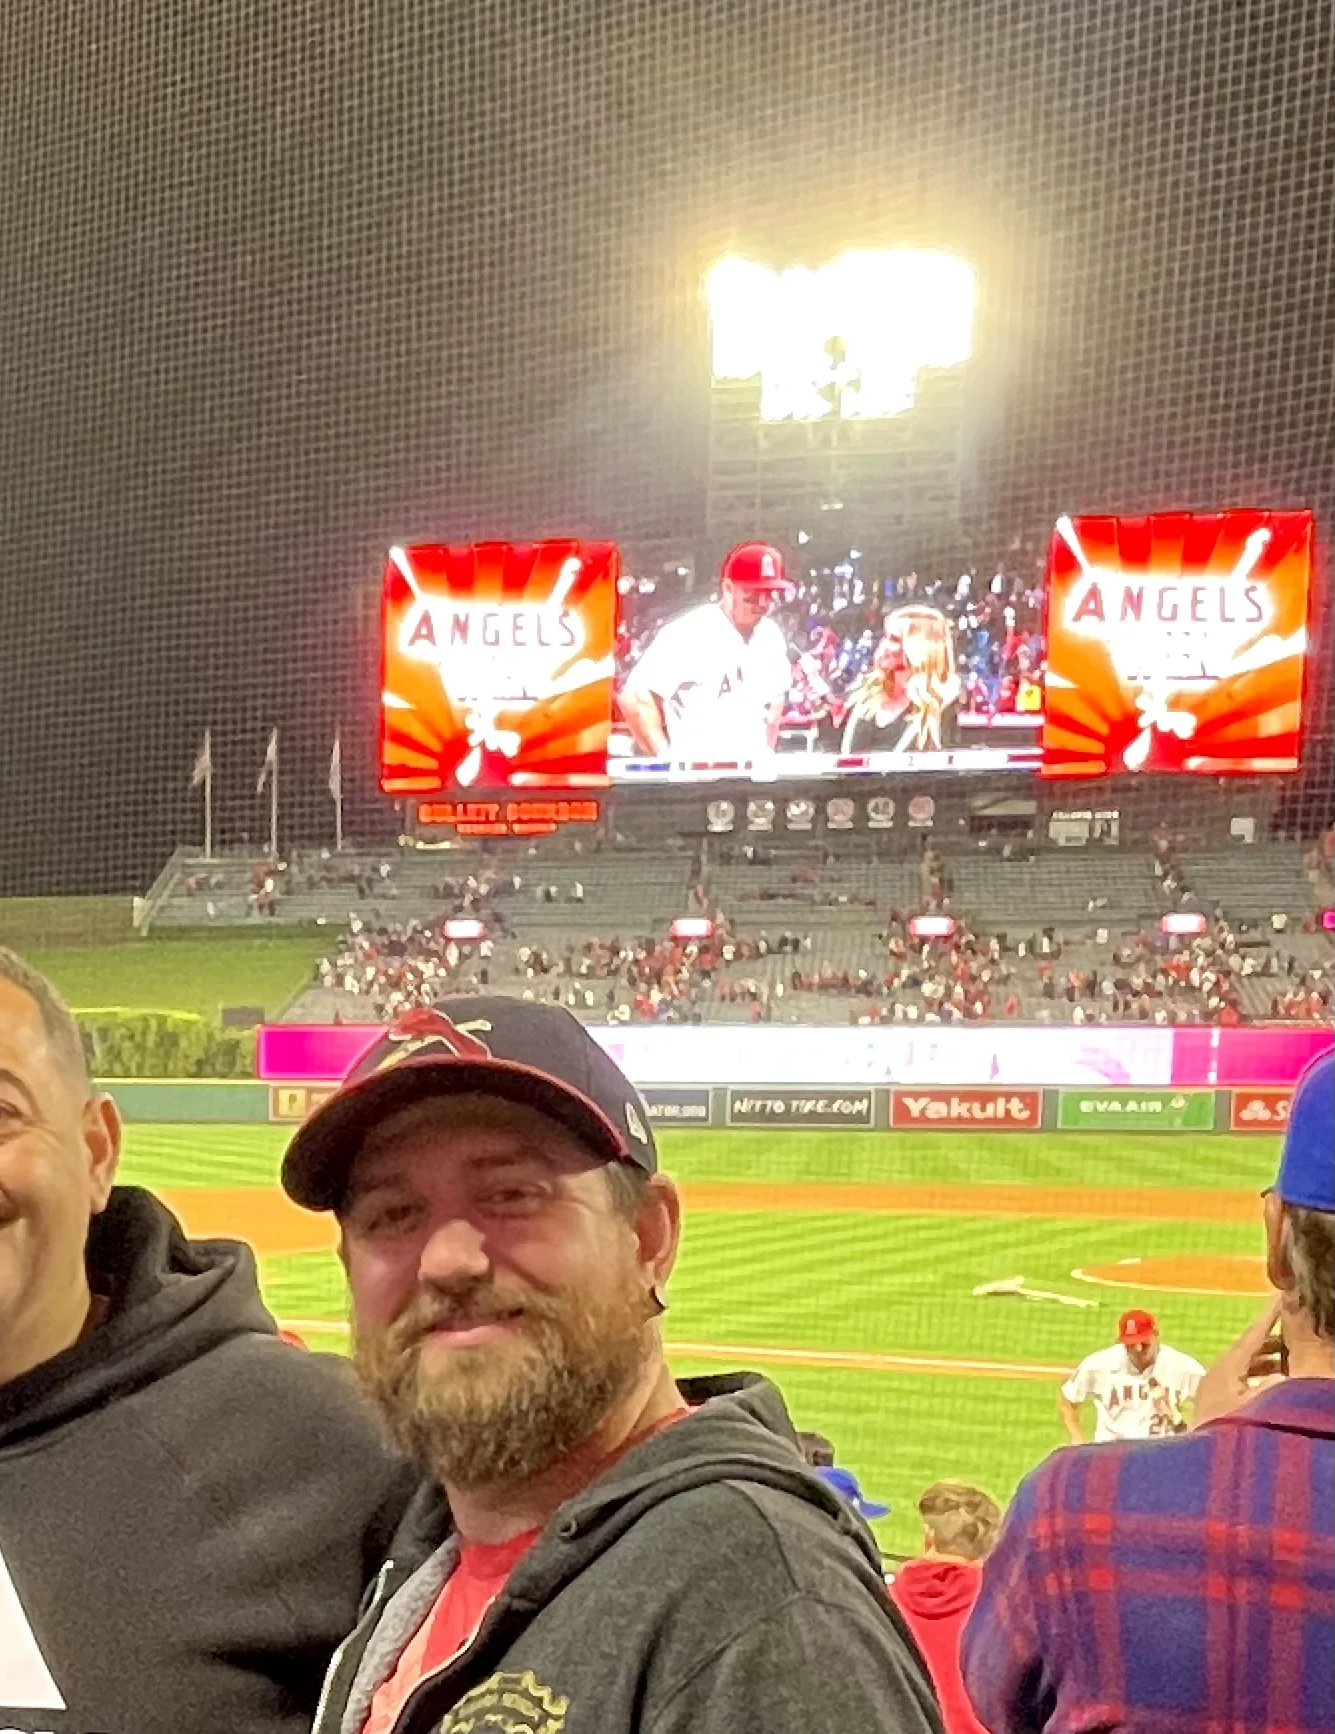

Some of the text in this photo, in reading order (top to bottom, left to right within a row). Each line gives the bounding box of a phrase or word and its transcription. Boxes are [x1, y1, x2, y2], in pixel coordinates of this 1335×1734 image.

[1072, 581, 1264, 622] ANGELS
[407, 608, 577, 647] ANGELS
[901, 1097, 1031, 1120] Yakult
